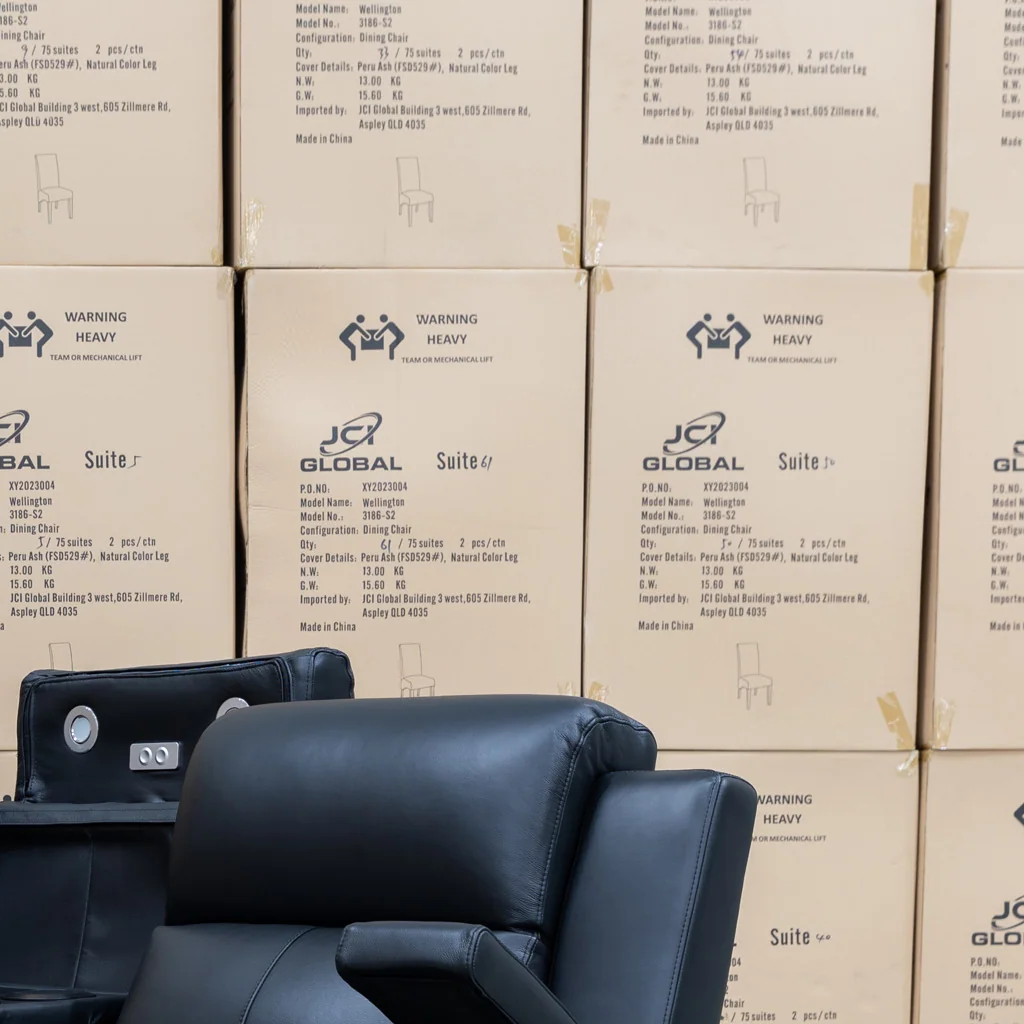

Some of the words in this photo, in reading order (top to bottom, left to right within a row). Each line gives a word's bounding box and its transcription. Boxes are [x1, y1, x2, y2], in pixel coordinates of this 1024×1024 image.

[359, 32, 386, 44] Dining
[388, 32, 408, 43] Chair
[359, 119, 386, 131] Aspley
[387, 118, 403, 130] QLD
[405, 119, 426, 130] 4035
[65, 312, 127, 322] WARNING
[416, 314, 478, 325] WARNING
[763, 314, 823, 325] WARNING
[76, 332, 116, 342] HEAVY
[427, 334, 467, 345] HEAVY
[773, 334, 812, 345] HEAVY
[85, 450, 126, 469] Suite
[300, 456, 402, 472] GLOBAL
[437, 451, 478, 470] Suite
[643, 456, 744, 471] GLOBAL
[778, 452, 819, 471] Suite
[10, 579, 33, 589] 15.60
[44, 578, 55, 589] KG
[638, 620, 660, 631] Made
[661, 621, 669, 630] in
[671, 620, 694, 631] China
[763, 814, 802, 824] HEAVY
[770, 928, 810, 946] Suite
